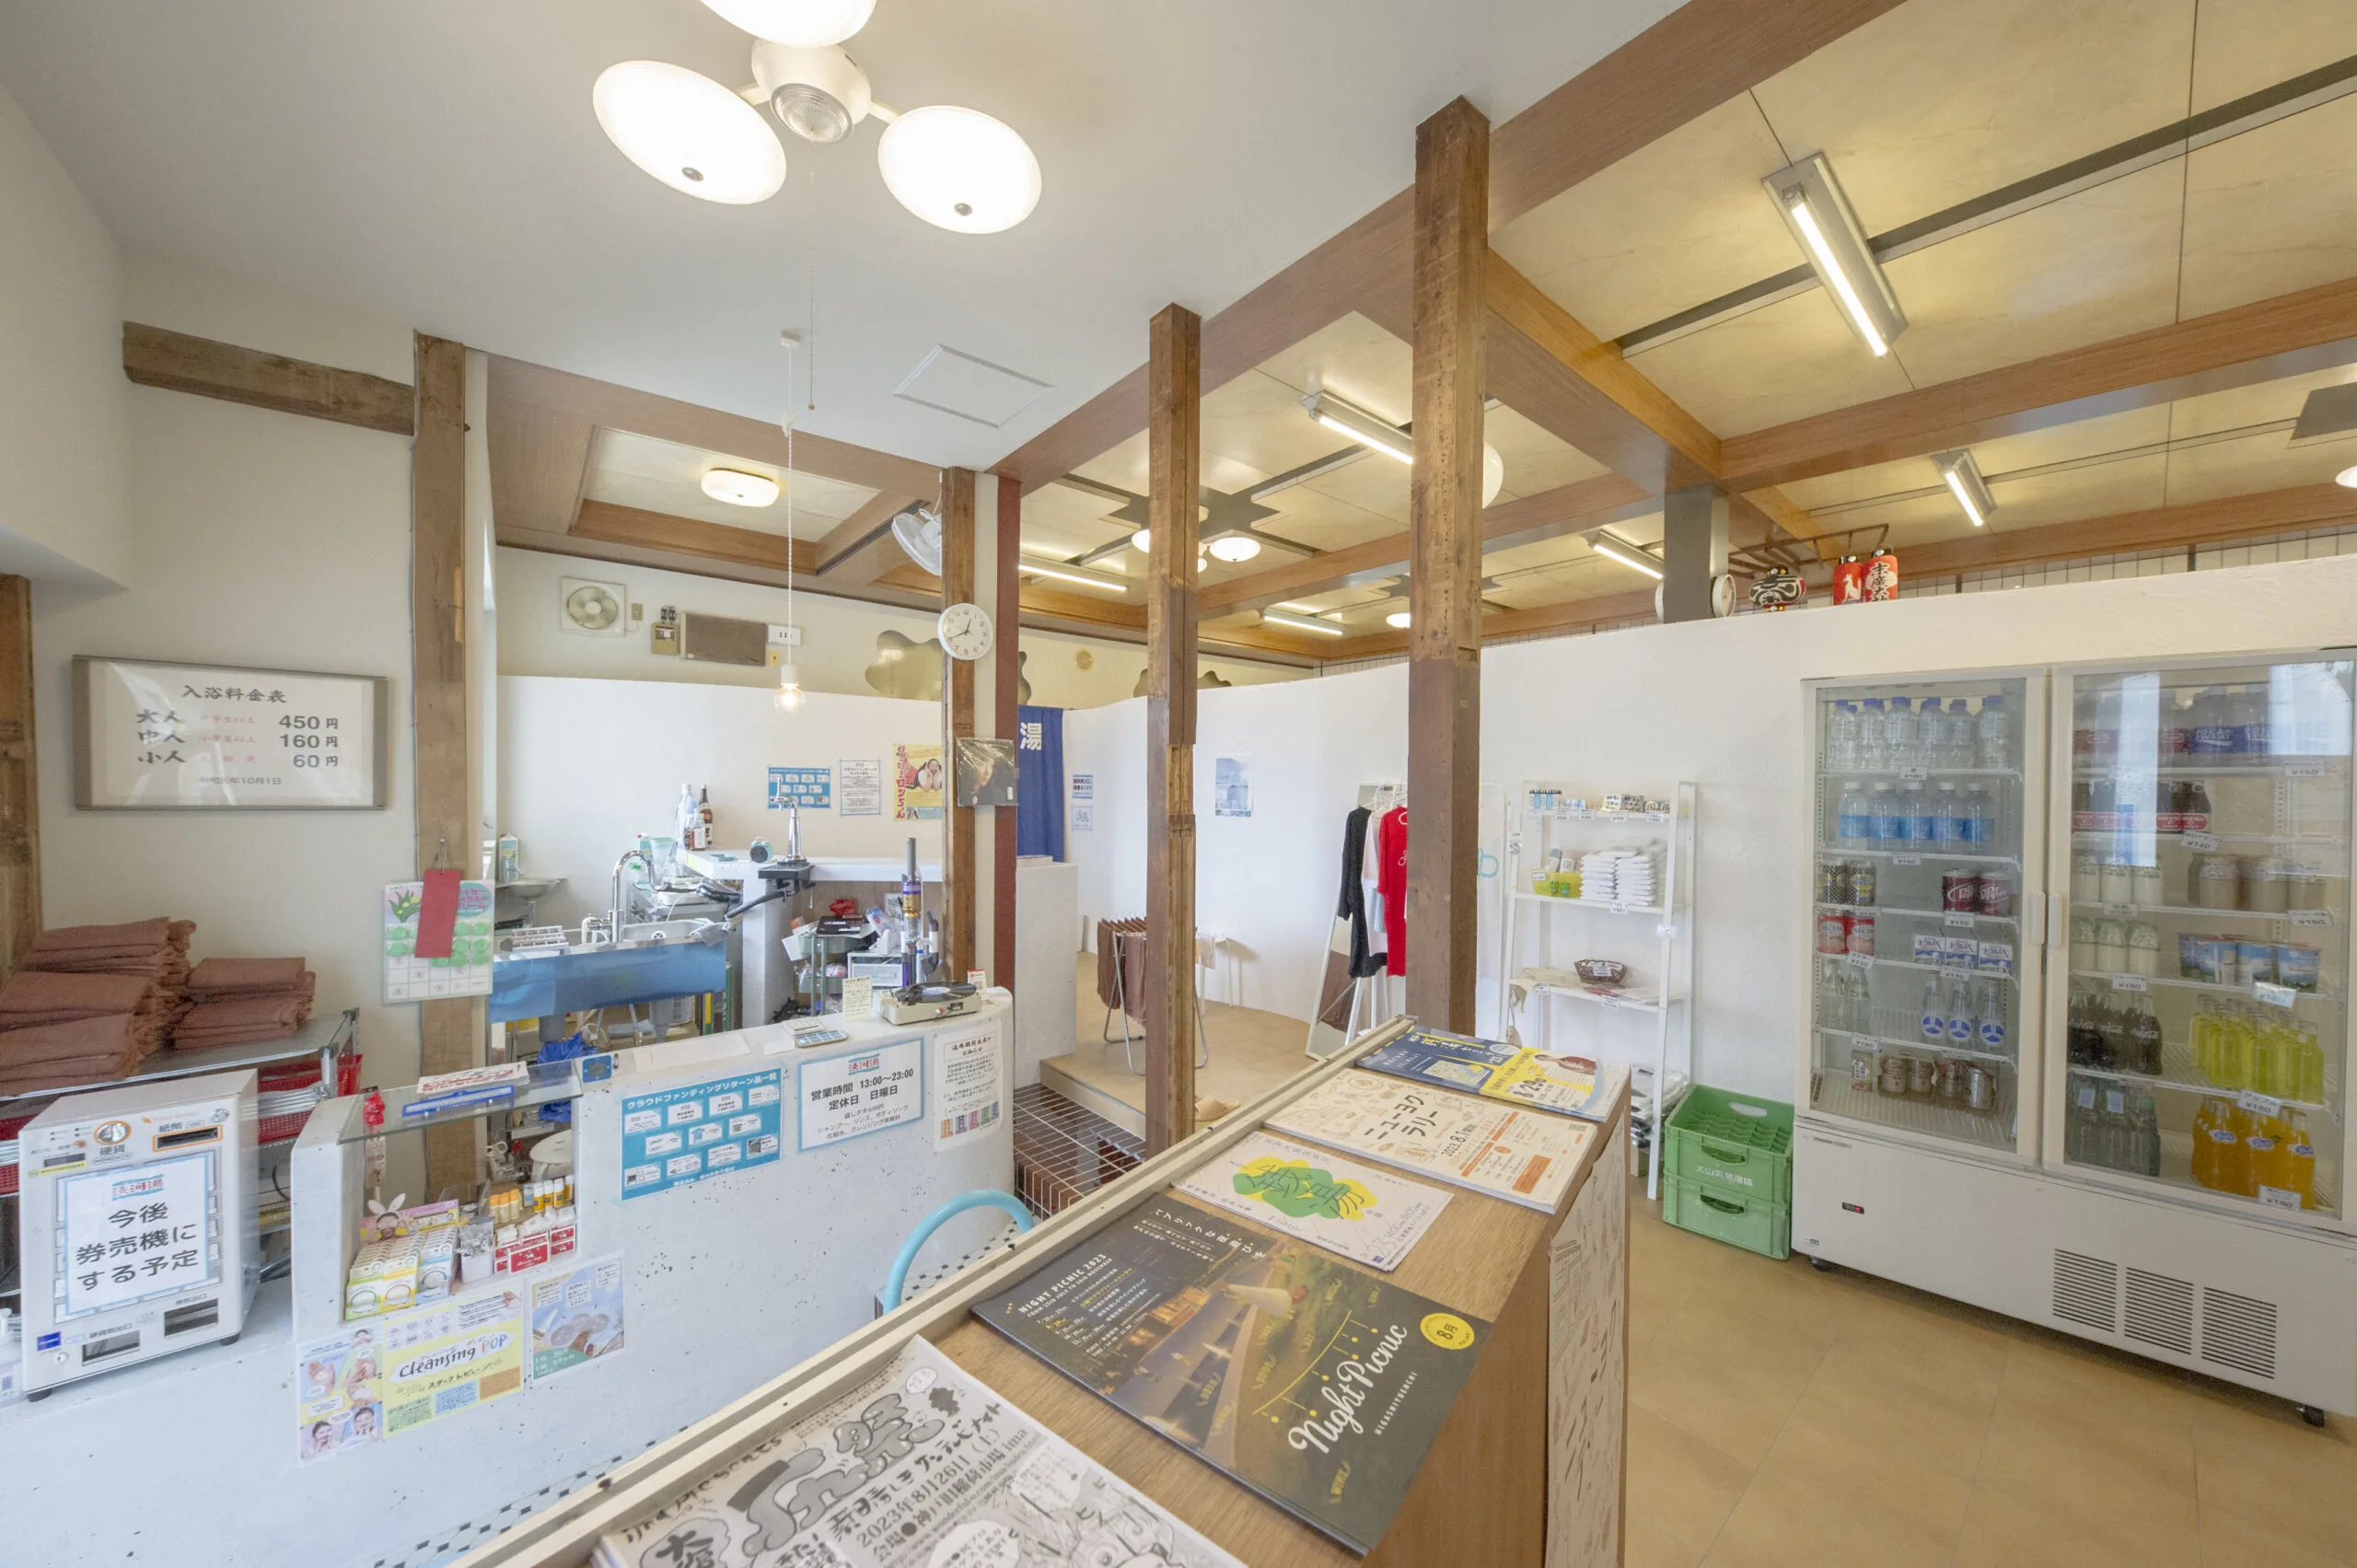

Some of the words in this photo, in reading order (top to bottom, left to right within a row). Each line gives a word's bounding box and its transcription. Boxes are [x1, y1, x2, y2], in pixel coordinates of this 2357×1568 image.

[182, 685, 287, 703] 入浴料金表
[136, 709, 186, 724] 大人
[278, 714, 339, 730] 450円
[280, 735, 339, 749] 160円
[1019, 722, 1042, 750] 湯
[137, 750, 187, 764] 小人
[293, 754, 339, 768] 60円
[627, 1071, 777, 1110] クラウドファンディングリターン品一覧
[810, 1082, 853, 1102] 営業時間
[829, 1094, 859, 1111] 定休日
[870, 1085, 899, 1101] 日曜日
[1364, 1094, 1426, 1140] ニューヨク
[1399, 1109, 1439, 1138] ラリー
[109, 1202, 168, 1228] 今後
[76, 1223, 197, 1266] 券売機に
[77, 1249, 199, 1292] する予定
[1016, 1291, 1053, 1313] NIGHT
[1048, 1268, 1086, 1292] PICNIC
[1080, 1253, 1109, 1270] 2023
[482, 1334, 507, 1354] POP
[1288, 1383, 1365, 1455] Night
[1337, 1324, 1409, 1388] Picnic
